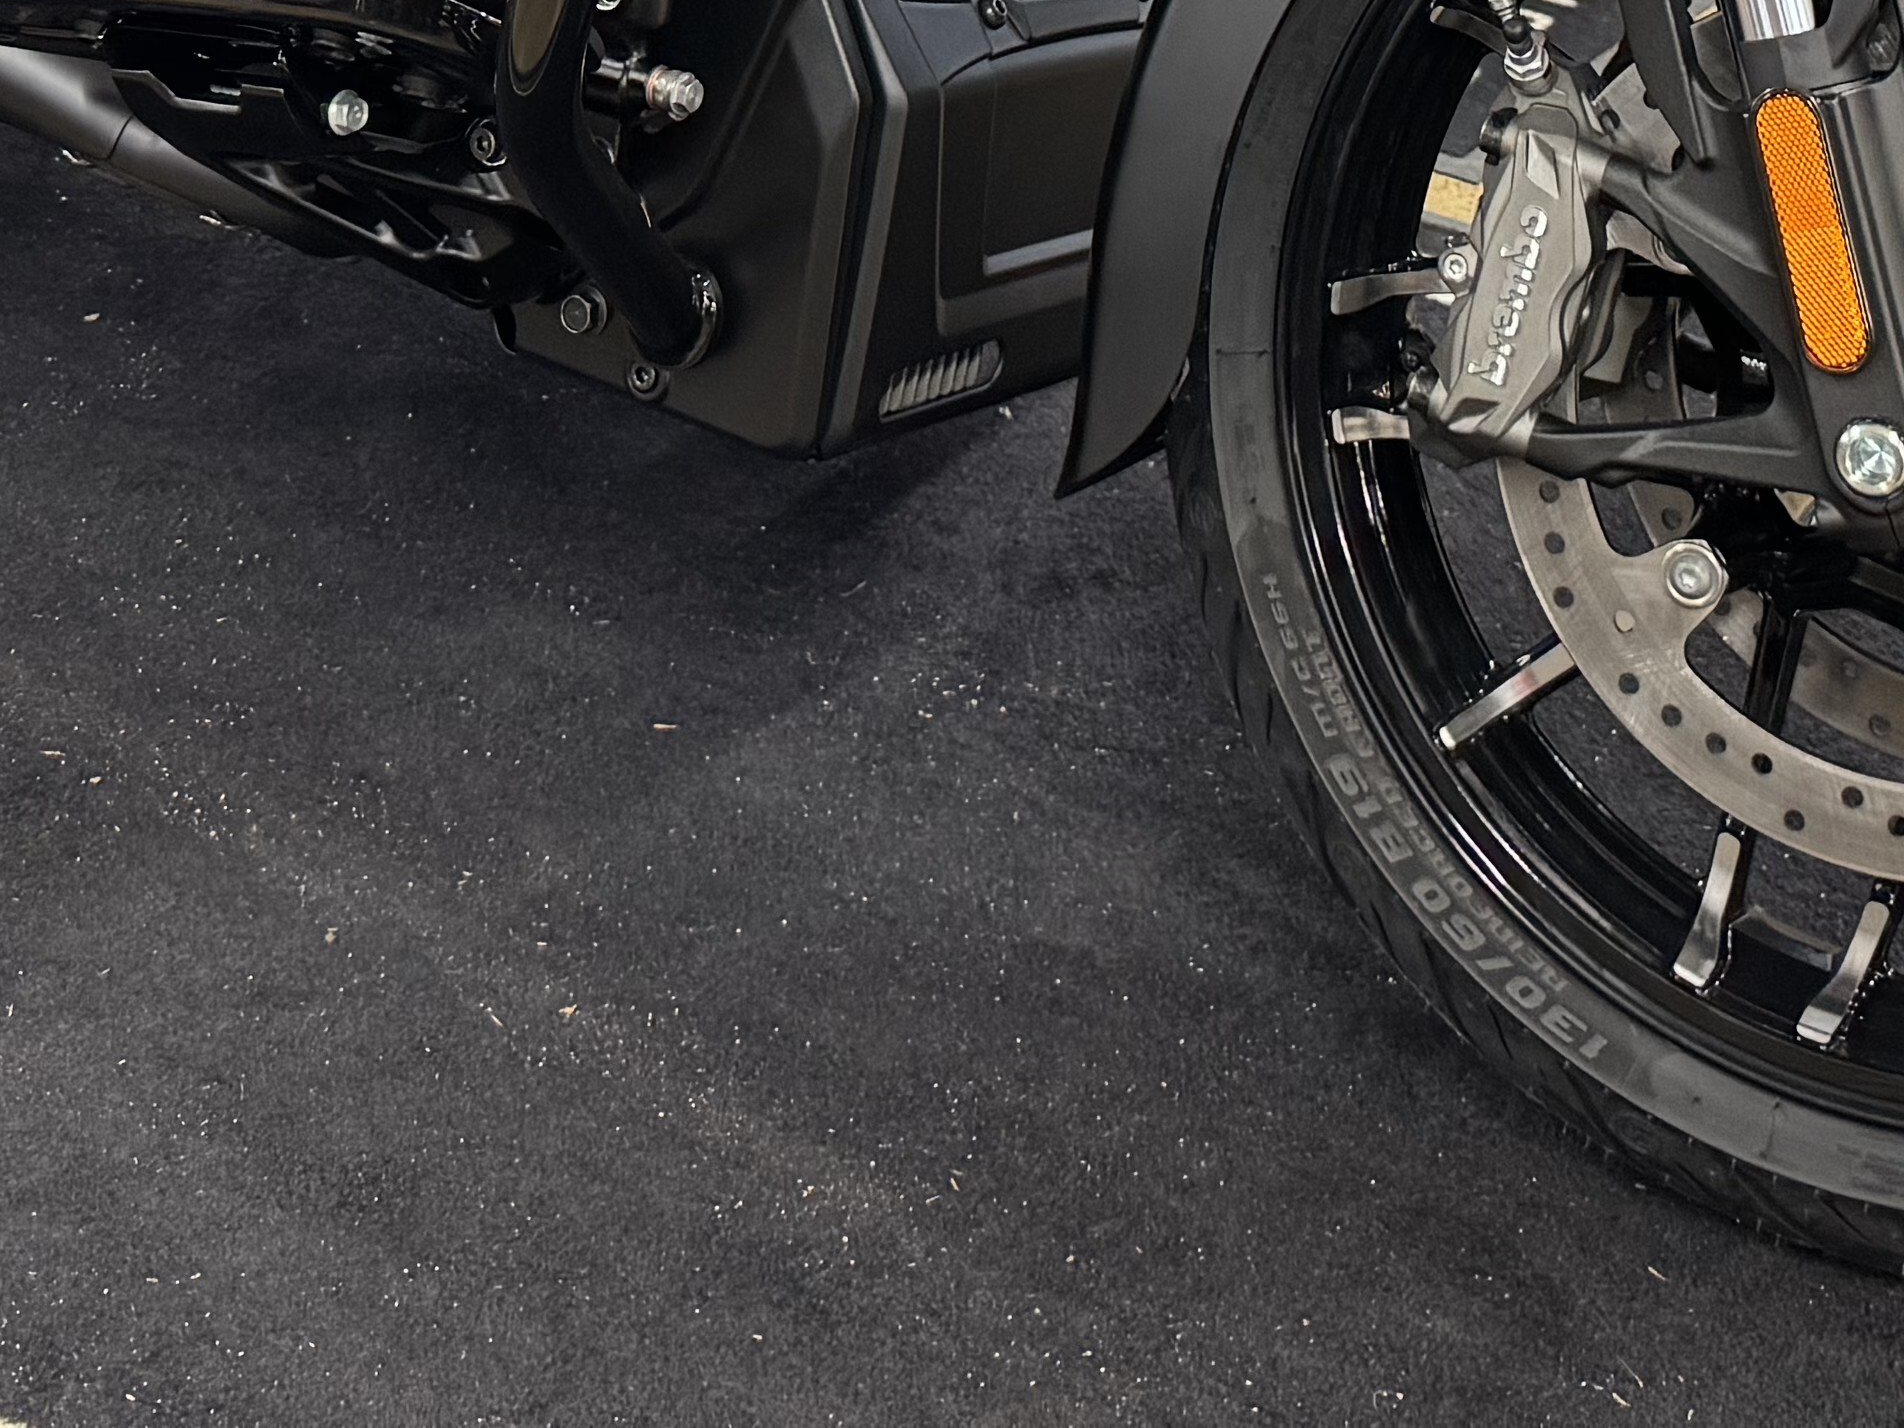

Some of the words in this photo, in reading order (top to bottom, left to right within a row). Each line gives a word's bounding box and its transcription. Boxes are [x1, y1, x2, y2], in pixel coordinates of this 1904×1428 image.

[1466, 204, 1549, 388] brembo
[1324, 753, 1415, 864] B19
[1410, 876, 1609, 1060] 130/60
